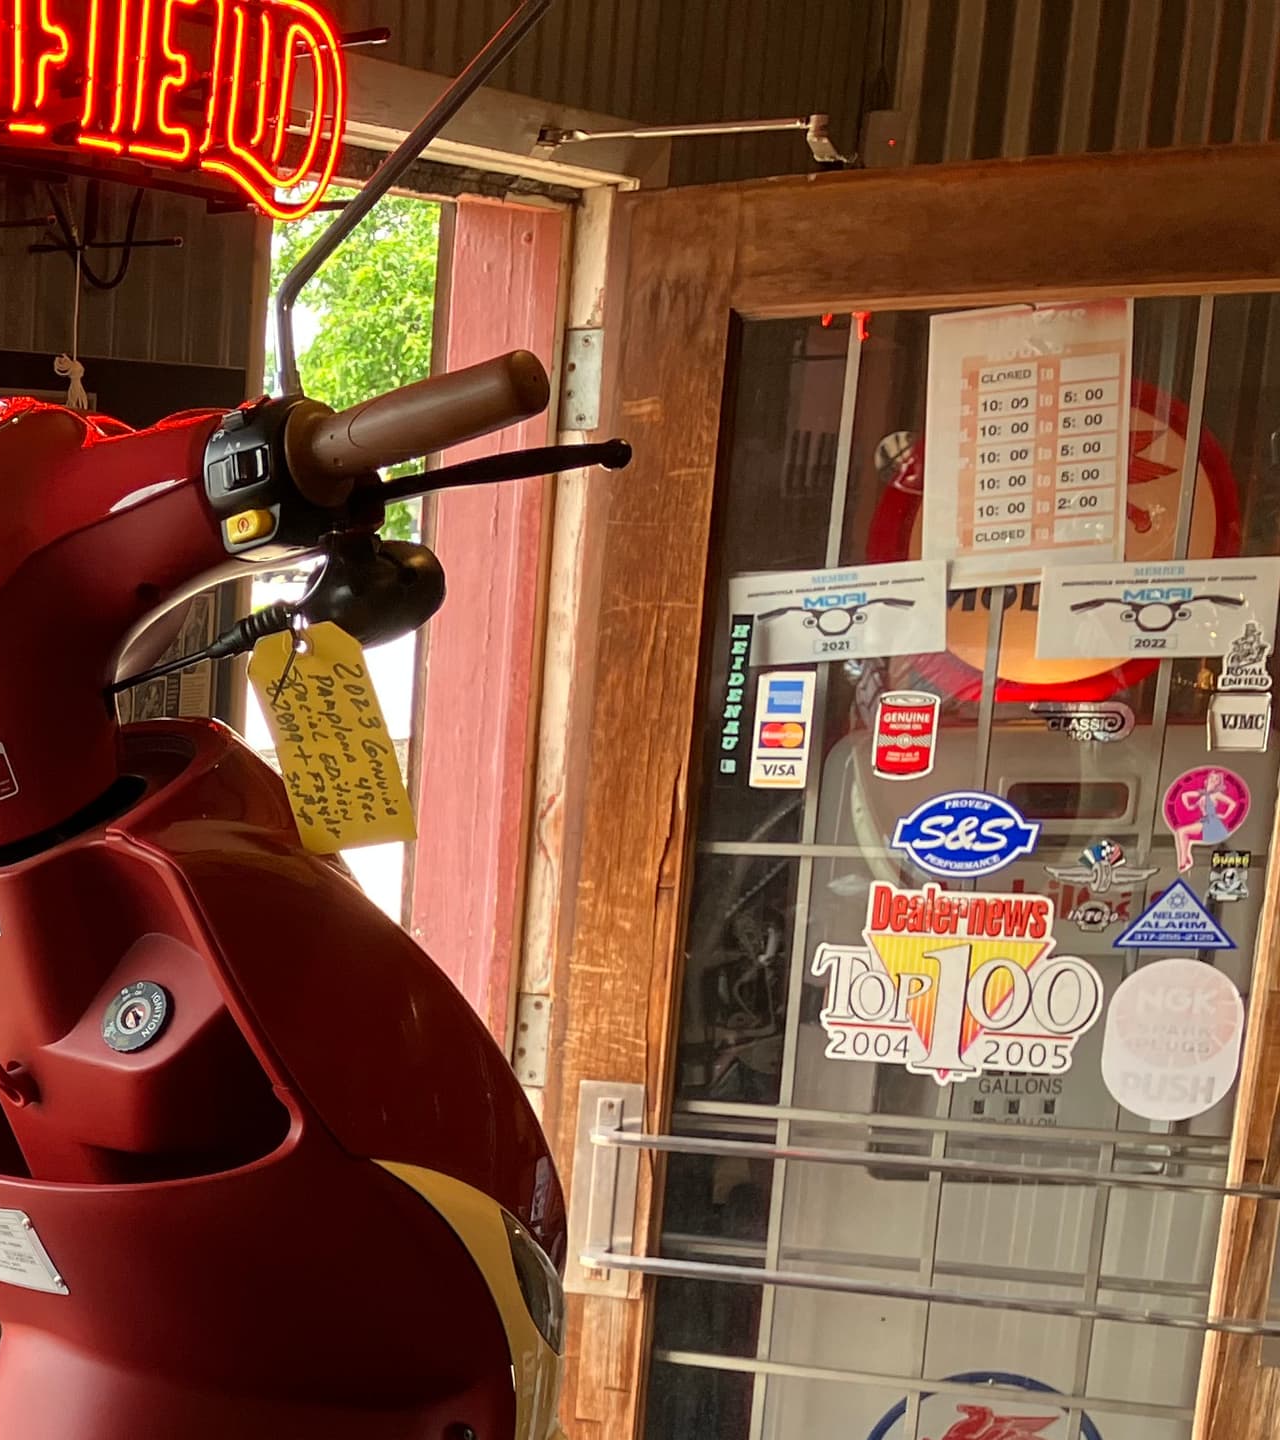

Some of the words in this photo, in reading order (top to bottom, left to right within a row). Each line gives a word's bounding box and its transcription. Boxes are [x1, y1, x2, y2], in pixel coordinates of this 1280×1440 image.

[981, 368, 1032, 385] CLOSED
[975, 528, 1025, 543] CLOSED
[803, 592, 867, 608] MDAI
[1123, 587, 1193, 601] MDAI
[821, 640, 851, 652] 2021
[1134, 638, 1167, 649] 2022
[1226, 667, 1265, 676] ROYAL
[1221, 677, 1269, 687] ENFIELD
[333, 662, 382, 730] 2023
[883, 711, 931, 723] GENUINE
[1221, 713, 1265, 730] VJMC
[761, 764, 796, 776] VISA
[944, 799, 991, 811] PROVEN
[912, 815, 1015, 852] S&S
[923, 853, 1001, 870] PERFORMANCE
[871, 885, 1050, 938] Dealernews
[1153, 911, 1200, 920] NELSON
[1141, 921, 1208, 929] ALARM
[912, 944, 1100, 1072] 100
[1136, 986, 1218, 1014] NGK
[141, 991, 163, 1038] IGNITION
[830, 1031, 910, 1058] 2004
[983, 1040, 1070, 1069] 2005
[978, 1078, 1063, 1094] GALLONS
[1121, 1072, 1216, 1105] PUSH
